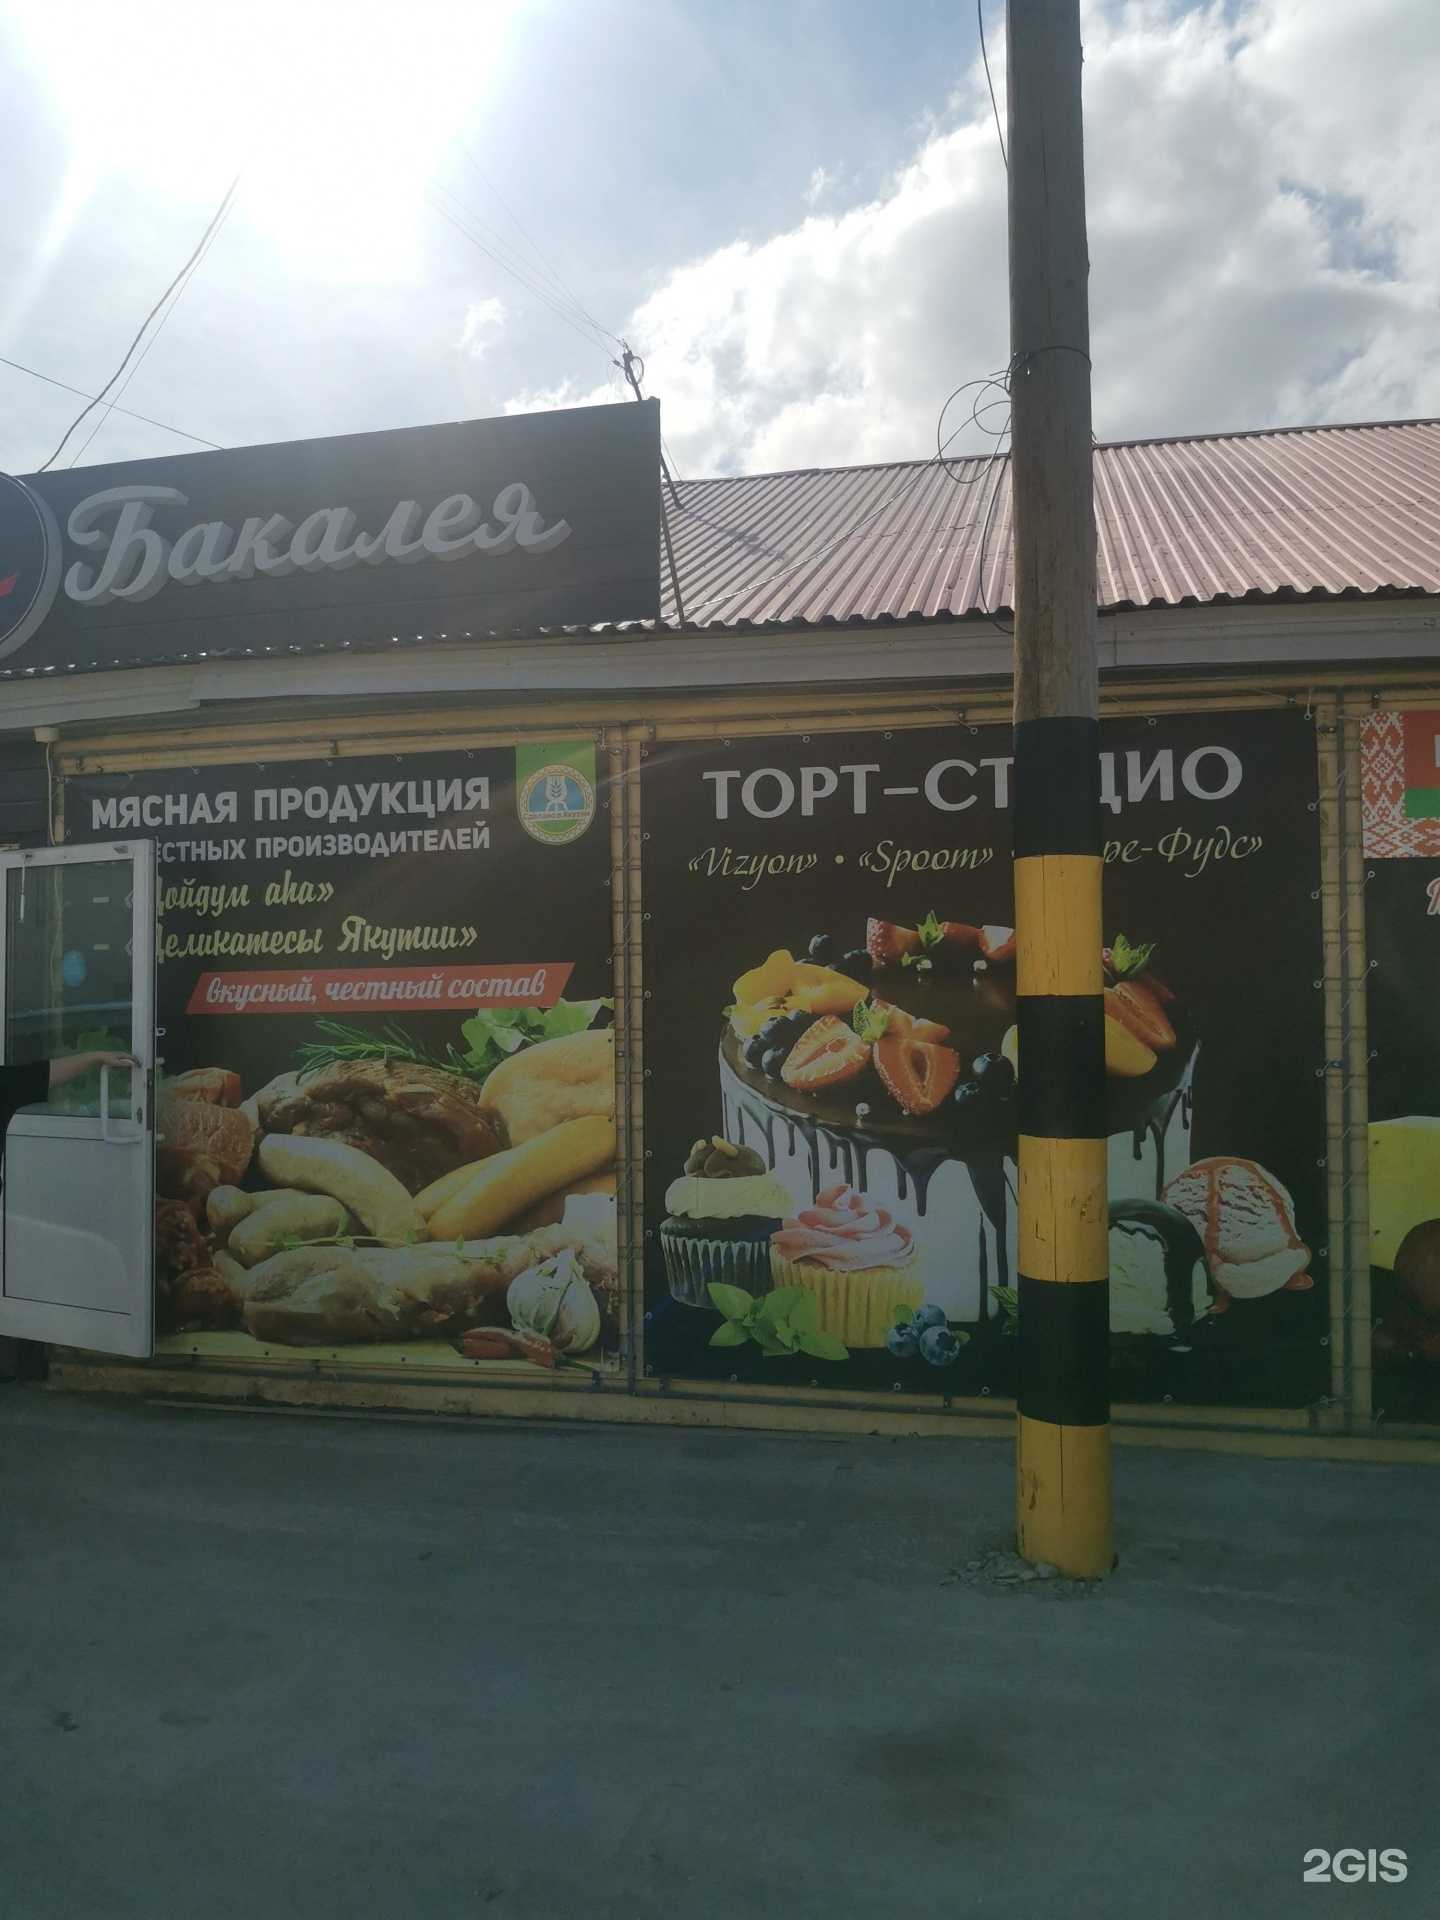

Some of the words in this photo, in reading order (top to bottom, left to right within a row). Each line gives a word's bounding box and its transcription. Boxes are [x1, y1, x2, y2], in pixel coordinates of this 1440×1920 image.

[64, 482, 572, 605] Бакалея
[91, 790, 238, 830] МЯСНАЯ
[254, 776, 490, 825] ПРОДУКЦИЯ
[157, 838, 247, 864] СТНЫХ
[255, 821, 490, 860] ПРОИЗВОДИТЕЛЕЙ
[859, 839, 994, 888] «Spoom»
[337, 915, 478, 960] Якутии»
[205, 976, 317, 1011] вкусный,
[325, 974, 441, 1001] честный
[447, 969, 546, 999] состав
